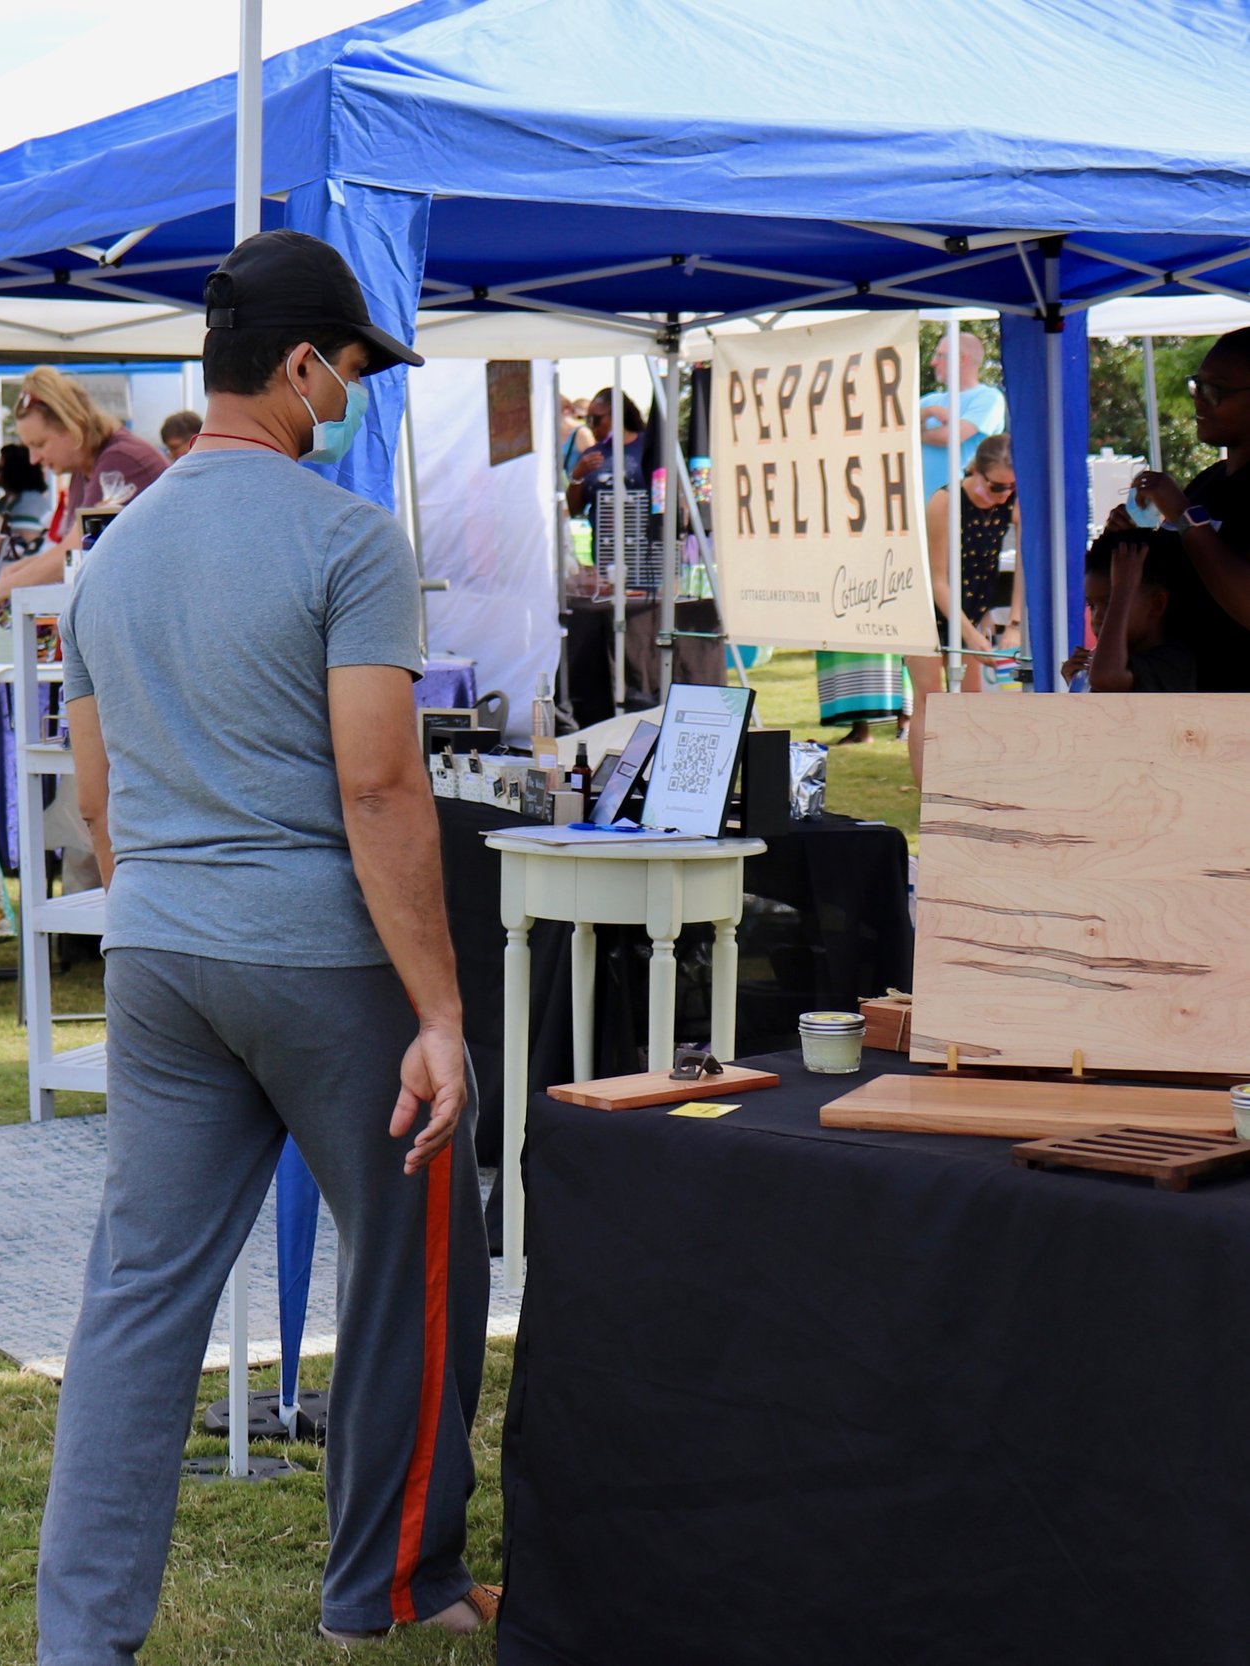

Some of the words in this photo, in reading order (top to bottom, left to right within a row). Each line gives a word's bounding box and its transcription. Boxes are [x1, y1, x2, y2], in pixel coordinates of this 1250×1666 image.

[727, 345, 906, 446] PEPPER
[734, 452, 910, 539] RELISH
[832, 564, 878, 618] Cottage
[877, 548, 913, 609] Lane
[856, 623, 899, 637] KITCHEN
